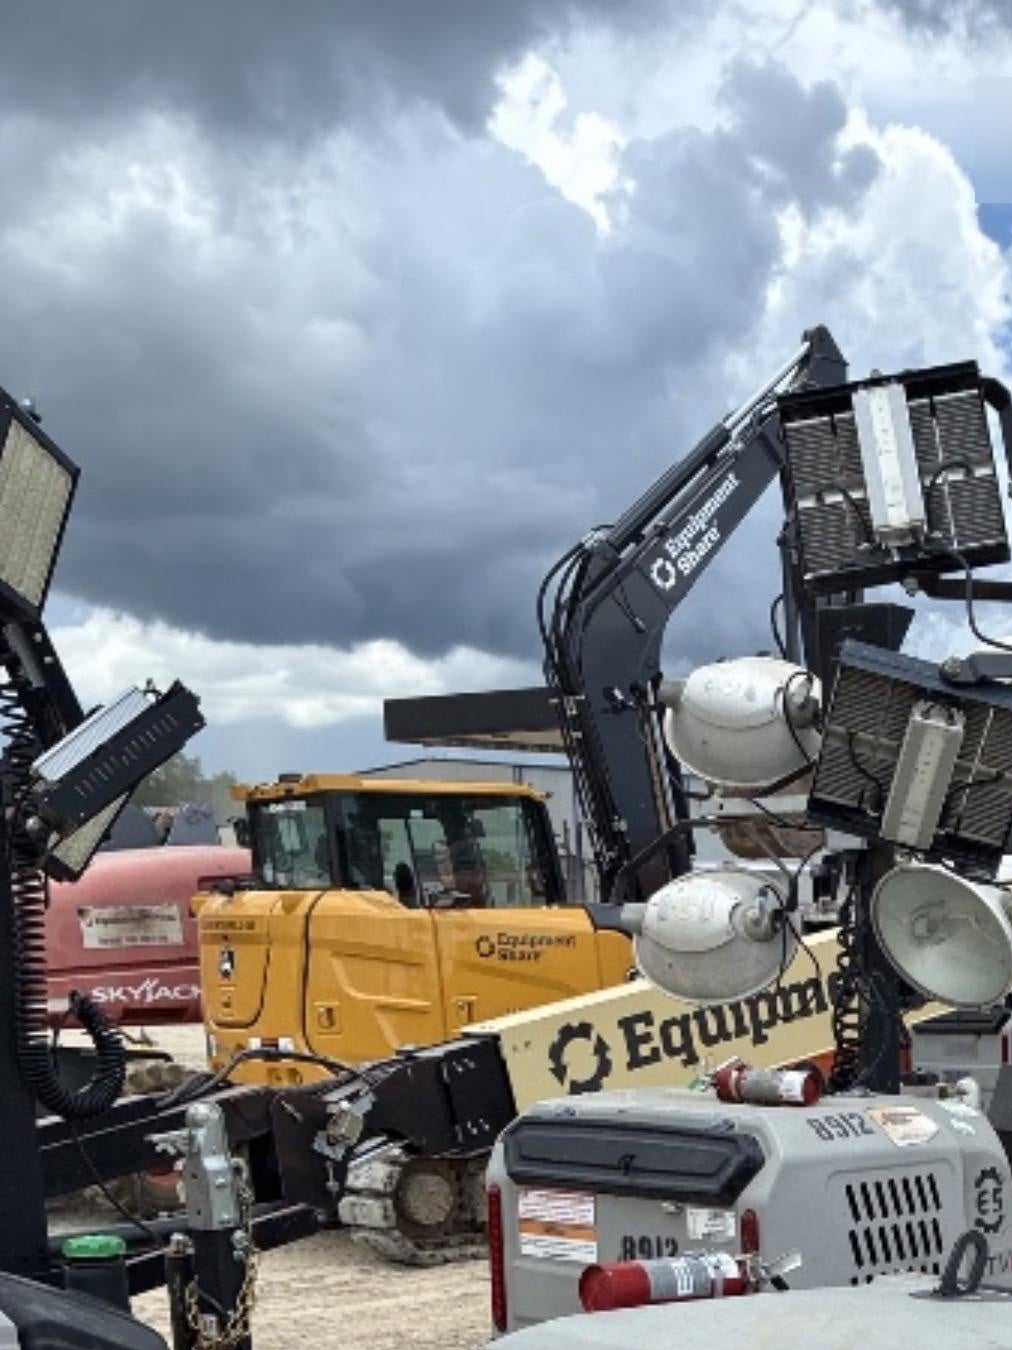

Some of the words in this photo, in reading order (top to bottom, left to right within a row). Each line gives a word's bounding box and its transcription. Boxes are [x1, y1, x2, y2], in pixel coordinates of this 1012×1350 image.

[664, 472, 740, 559] Equipment
[677, 526, 721, 576] Share
[618, 968, 858, 1071] Equipm
